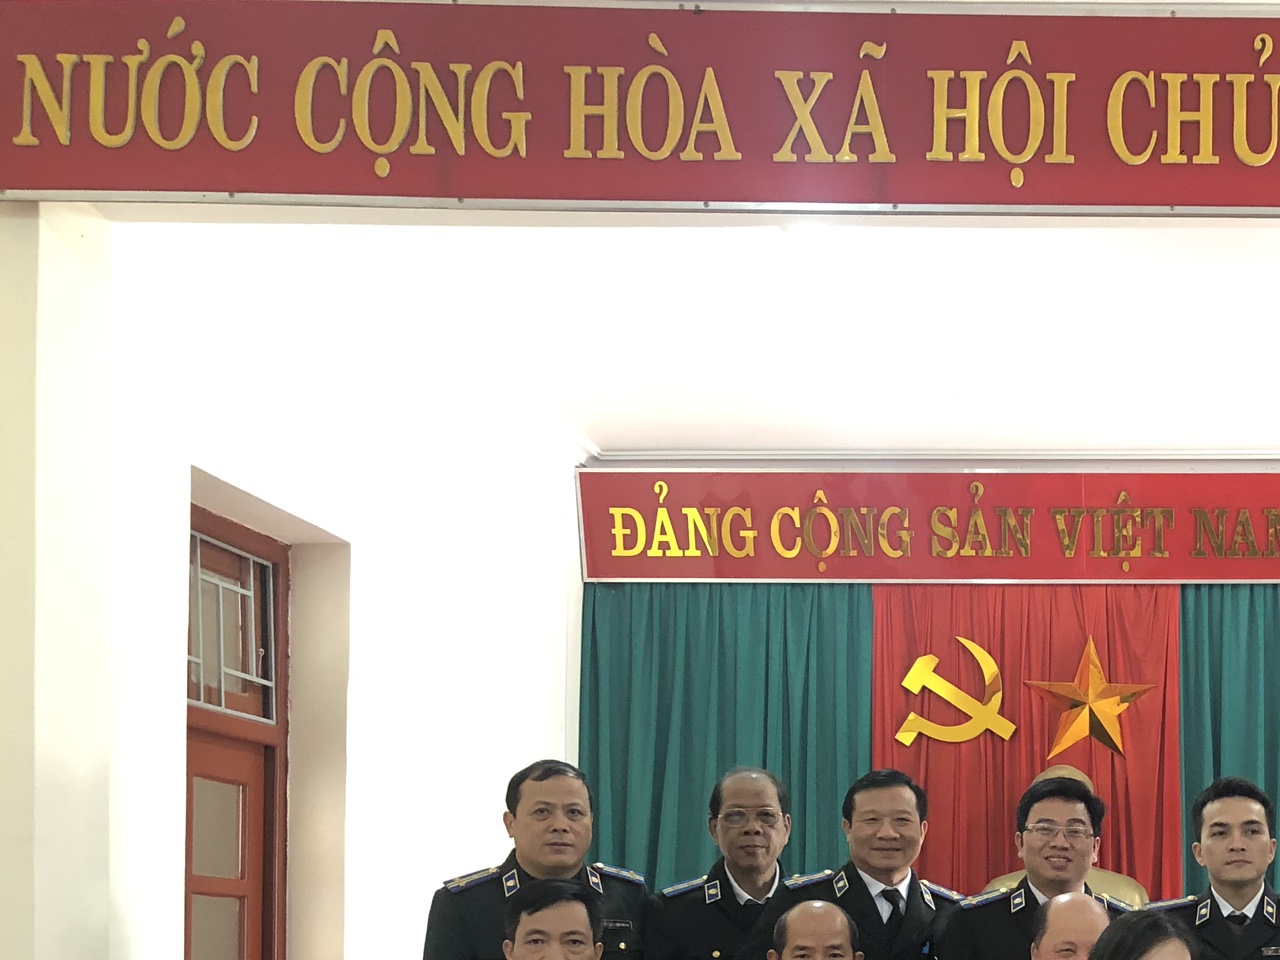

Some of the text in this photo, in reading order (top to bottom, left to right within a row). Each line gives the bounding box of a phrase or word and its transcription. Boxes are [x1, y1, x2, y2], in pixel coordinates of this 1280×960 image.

[13, 17, 258, 151] NƯỚC
[295, 30, 532, 177] CỘNG
[564, 33, 742, 162] HÒA
[773, 42, 897, 163] XÃ
[926, 40, 1077, 189] HỘI
[609, 481, 758, 557] ĐẢNG
[770, 489, 914, 572] CỘNG
[930, 481, 1034, 558] SẢN
[1049, 490, 1175, 572] VIỆT
